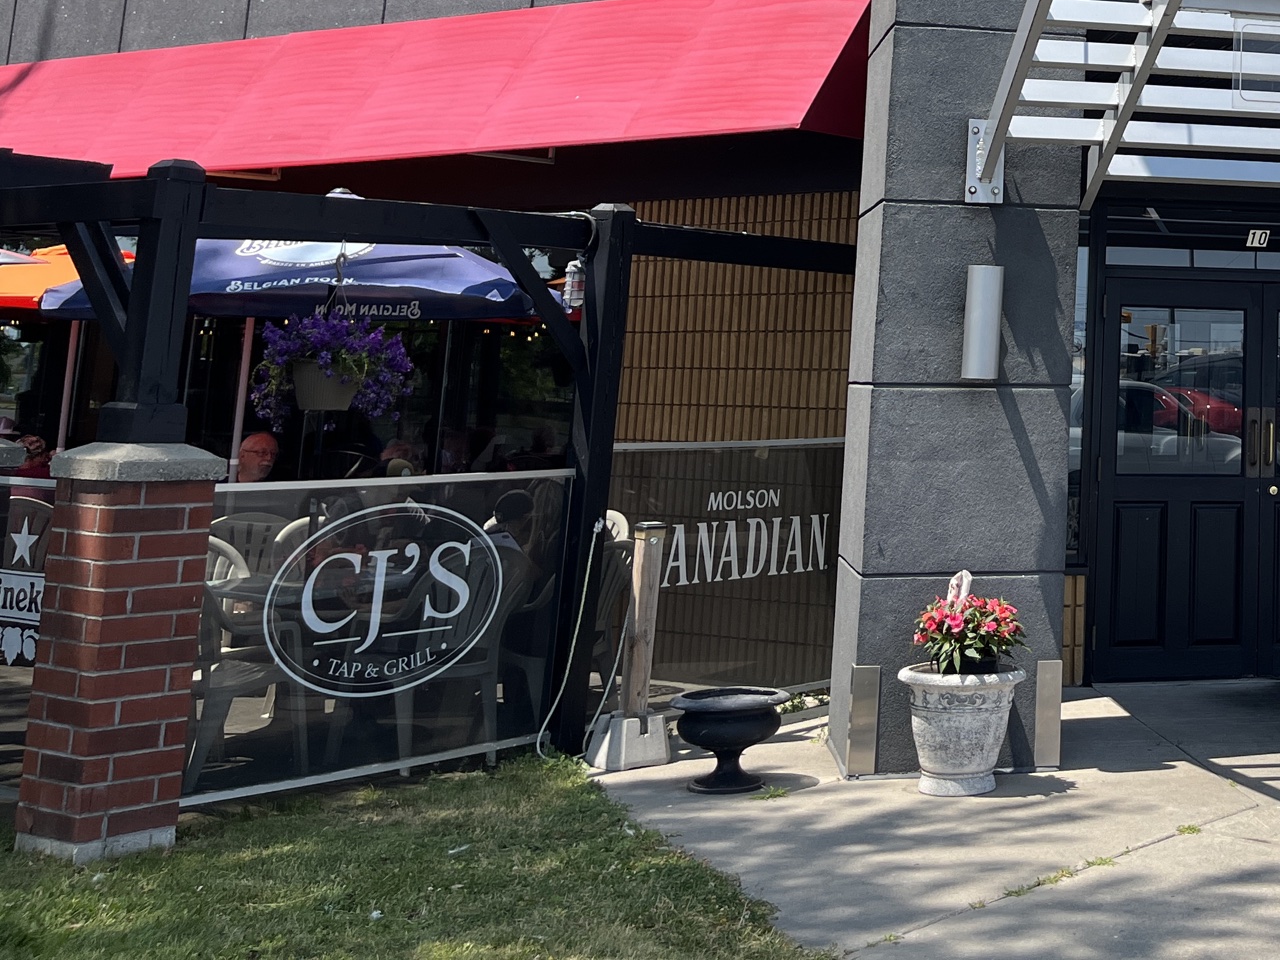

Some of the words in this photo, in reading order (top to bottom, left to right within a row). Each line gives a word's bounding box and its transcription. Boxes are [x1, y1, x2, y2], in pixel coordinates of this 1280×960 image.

[1250, 230, 1268, 246] 10
[226, 278, 301, 293] BELGIAN
[707, 489, 780, 511] MOLSON
[660, 513, 830, 588] ANADIAN
[301, 539, 472, 654] CJ'S
[328, 658, 361, 678] TAP
[364, 665, 379, 678] &
[384, 647, 436, 676] GRILL
